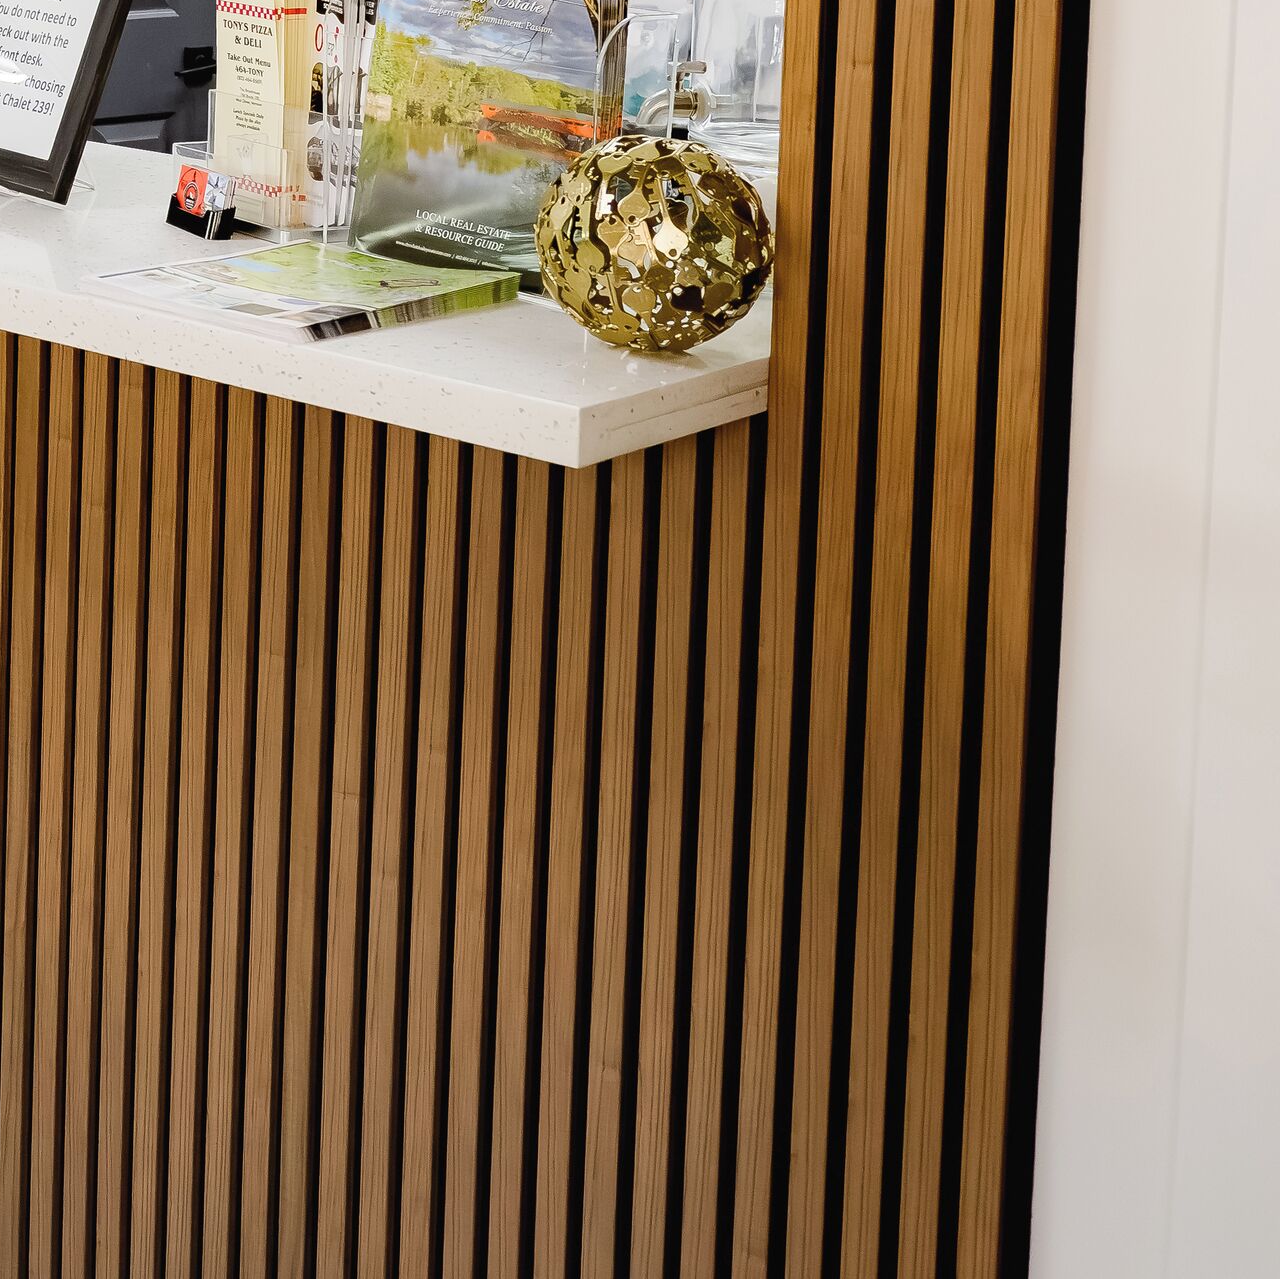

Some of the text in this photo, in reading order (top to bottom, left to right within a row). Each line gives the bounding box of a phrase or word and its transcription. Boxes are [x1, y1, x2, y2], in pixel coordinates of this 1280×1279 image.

[12, 3, 23, 18] do
[24, 8, 40, 21] not
[42, 9, 64, 26] need
[66, 15, 77, 27] to
[13, 28, 29, 42] out
[31, 30, 52, 45] with
[53, 32, 69, 49] the
[251, 23, 273, 36] PIZZA
[234, 35, 262, 48] & DELI
[20, 51, 43, 67] desk.
[227, 53, 271, 67] Take Out Menu
[24, 75, 66, 97] choosing
[2, 92, 31, 111] Chalet
[32, 99, 55, 116] 239!
[415, 209, 511, 240] LOCAL REAL ESTATE
[415, 224, 505, 252] & RESOURCE GUIDE
